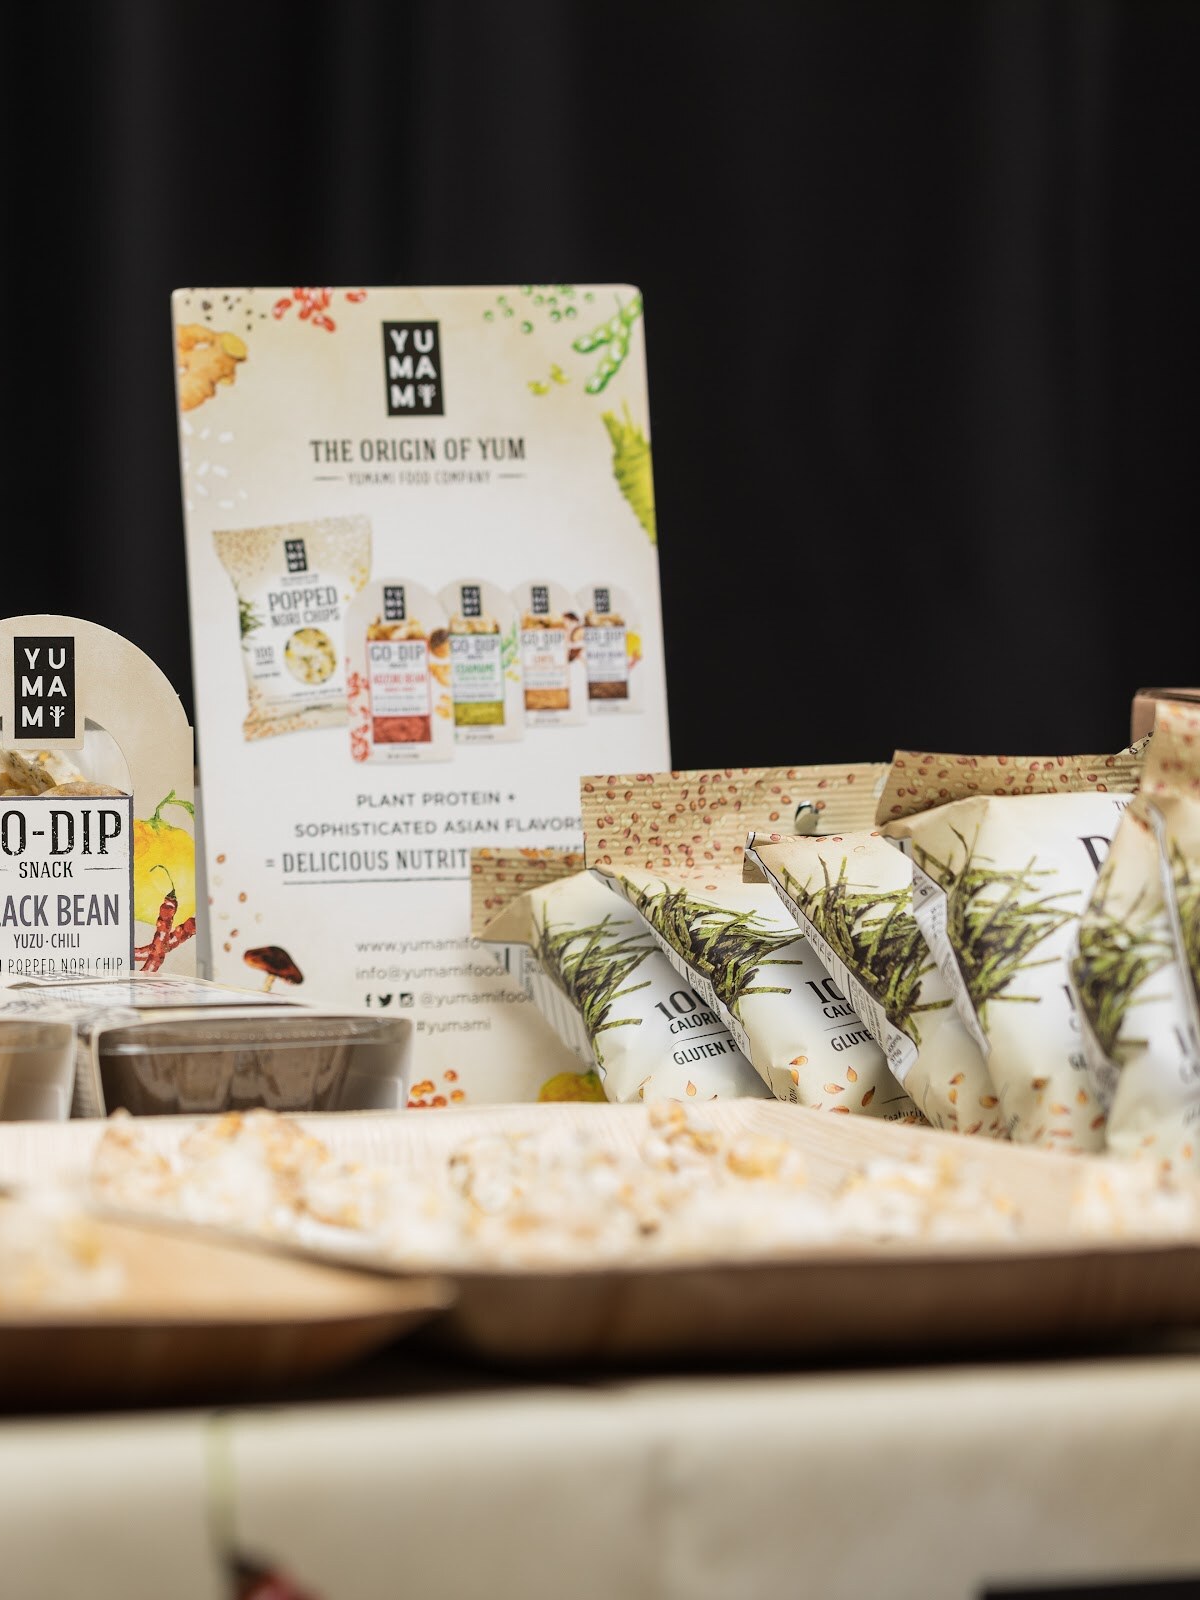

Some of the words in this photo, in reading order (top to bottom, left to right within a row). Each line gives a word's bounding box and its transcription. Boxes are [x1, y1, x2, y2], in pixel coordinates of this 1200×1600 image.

[390, 329, 434, 353] YU
[390, 356, 437, 379] MA
[309, 439, 353, 463] THE
[360, 438, 435, 462] ORIGIN
[444, 438, 471, 461] OF
[477, 437, 525, 461] YUM
[268, 587, 338, 611] POPPED
[24, 648, 66, 670] YU
[21, 675, 67, 697] MA
[357, 793, 414, 808] PLANT
[422, 792, 500, 807] PROTEIN
[294, 821, 437, 838] SOPHISTICATED
[444, 820, 499, 834] ASIAN
[18, 861, 74, 879] SNACK
[282, 850, 389, 874] DELICIOUS
[57, 893, 120, 926] BEAN
[13, 934, 44, 948] YUZU
[51, 933, 80, 948] CHILI
[8, 958, 55, 973] POPPED
[61, 957, 90, 971] NORI
[95, 957, 123, 971] CHIP
[416, 1019, 492, 1035] #yumami
[673, 1041, 727, 1065] GLUTEN
